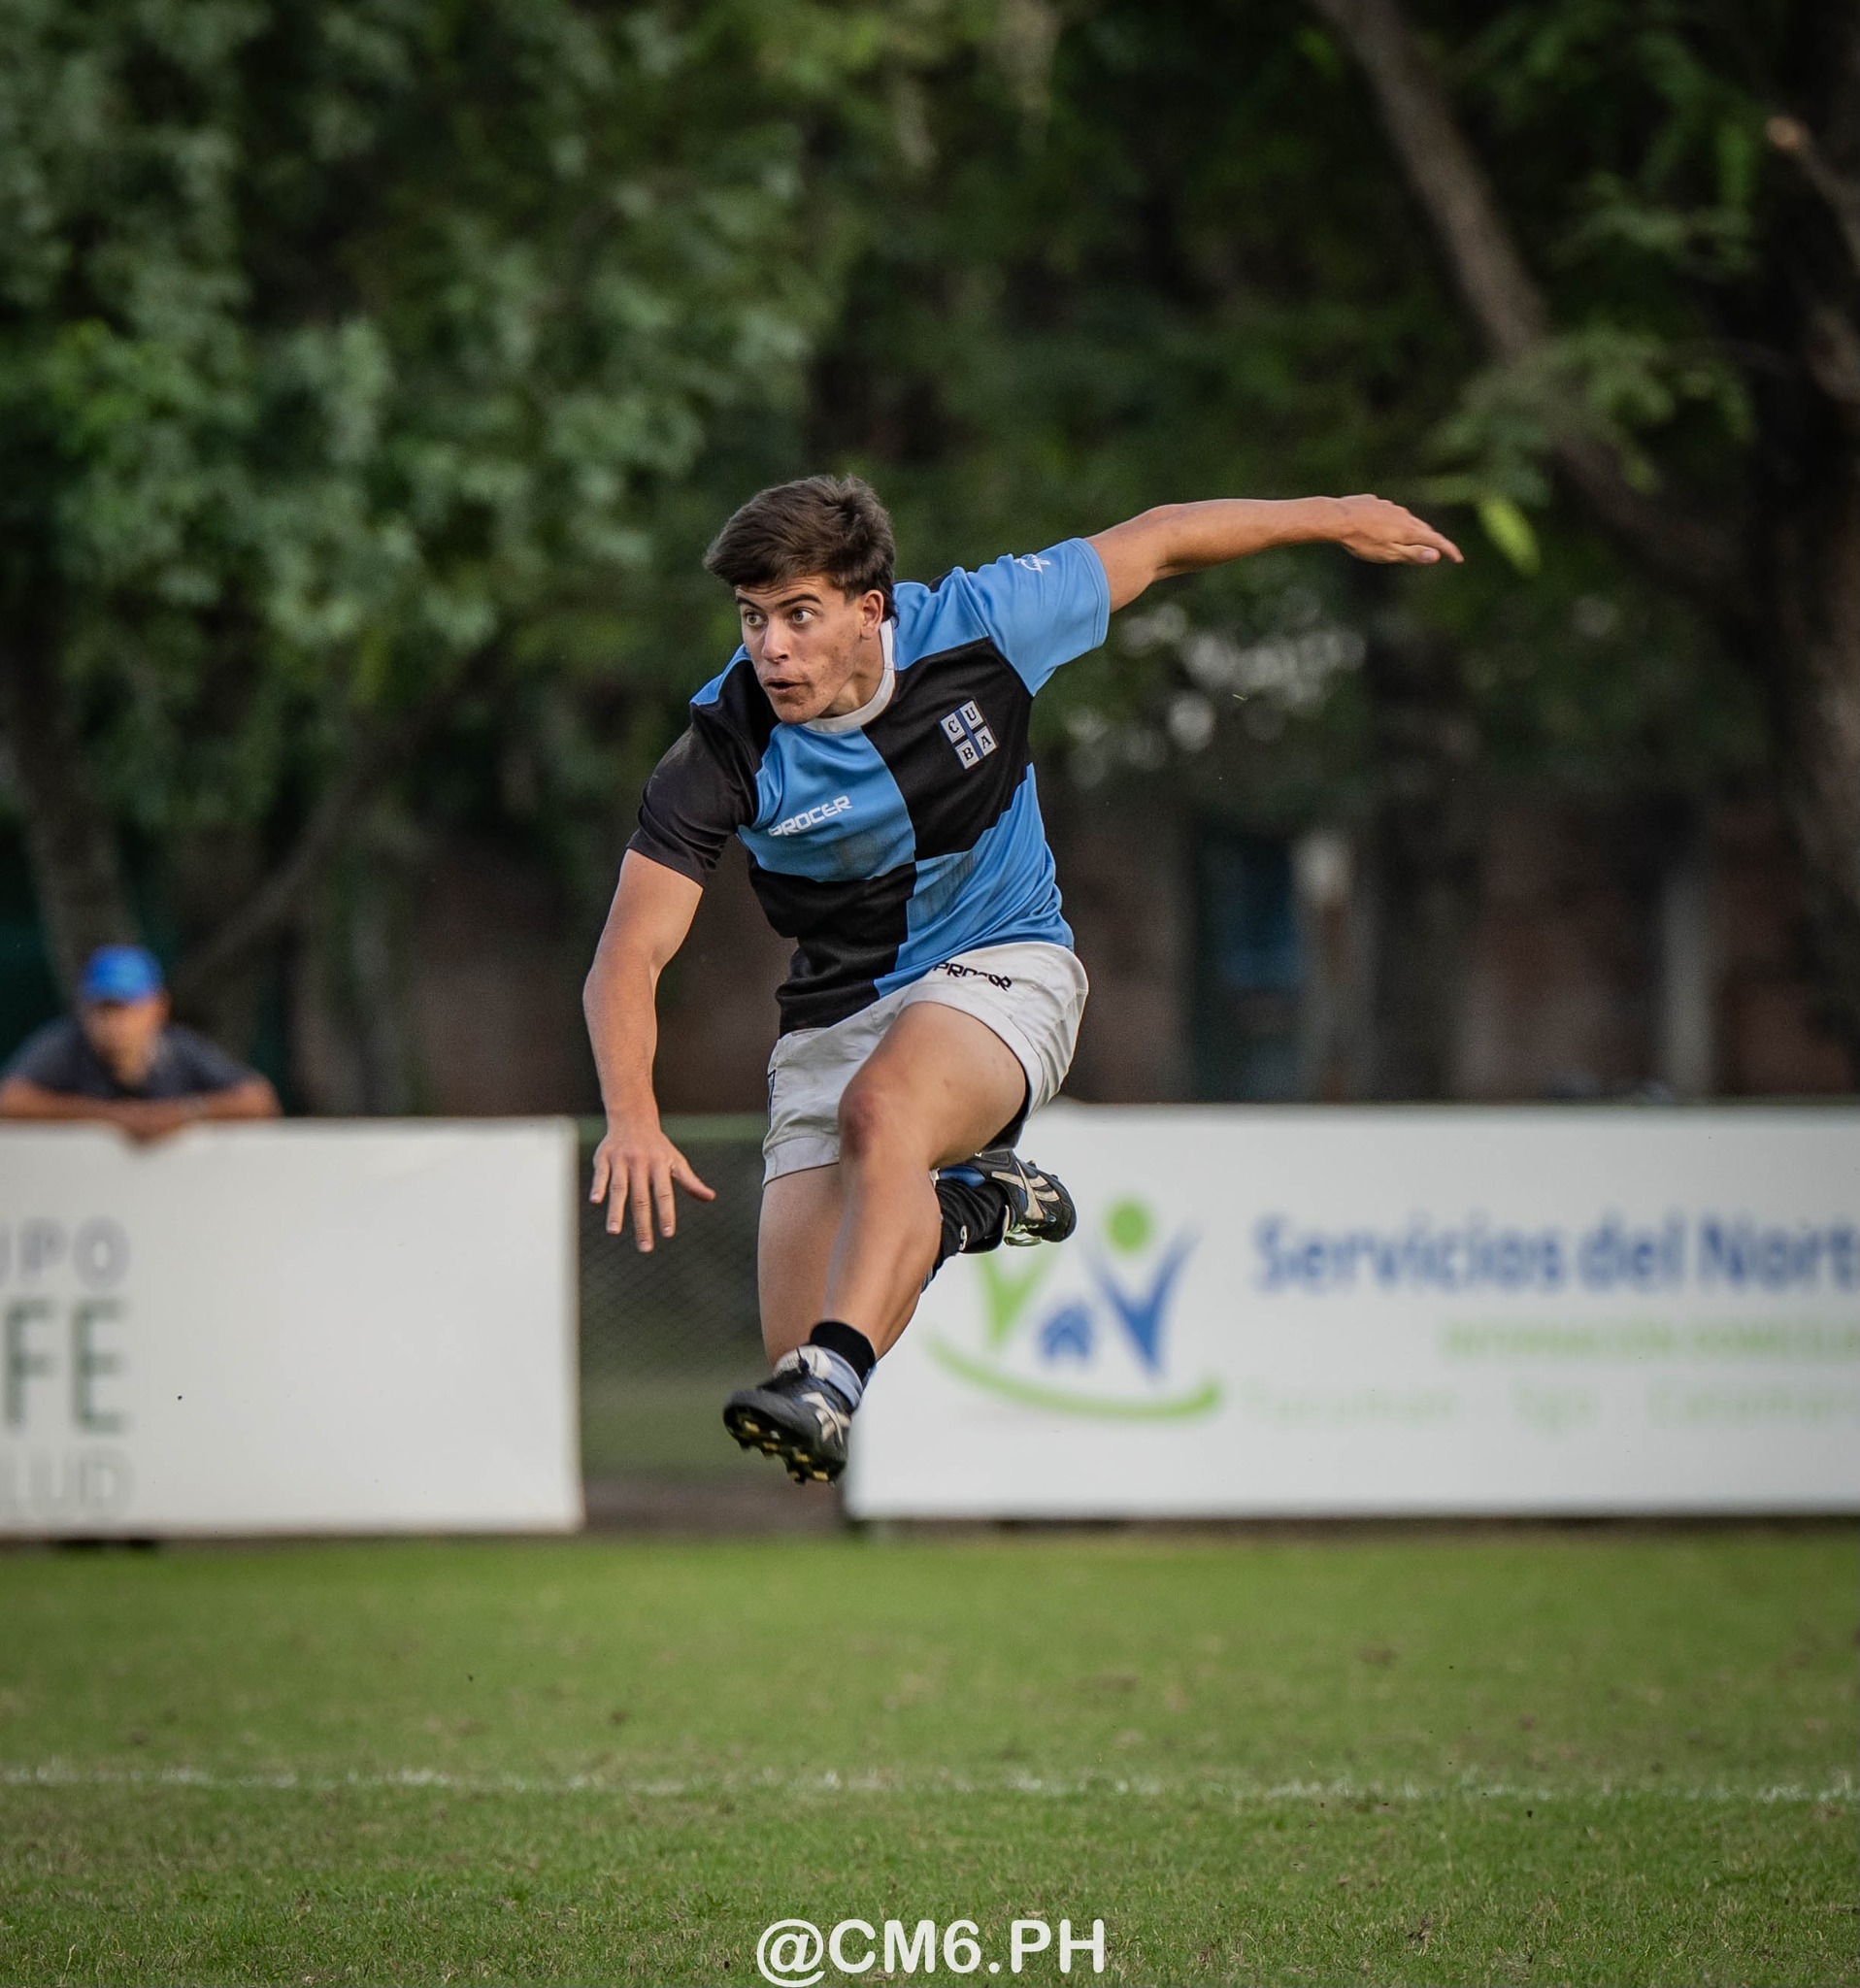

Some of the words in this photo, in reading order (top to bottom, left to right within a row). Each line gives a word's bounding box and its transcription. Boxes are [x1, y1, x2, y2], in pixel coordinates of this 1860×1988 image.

[933, 962, 1013, 991] PROR
[0, 1216, 130, 1292] PO
[1250, 1210, 1564, 1293] Servicios
[1578, 1208, 1687, 1293] del
